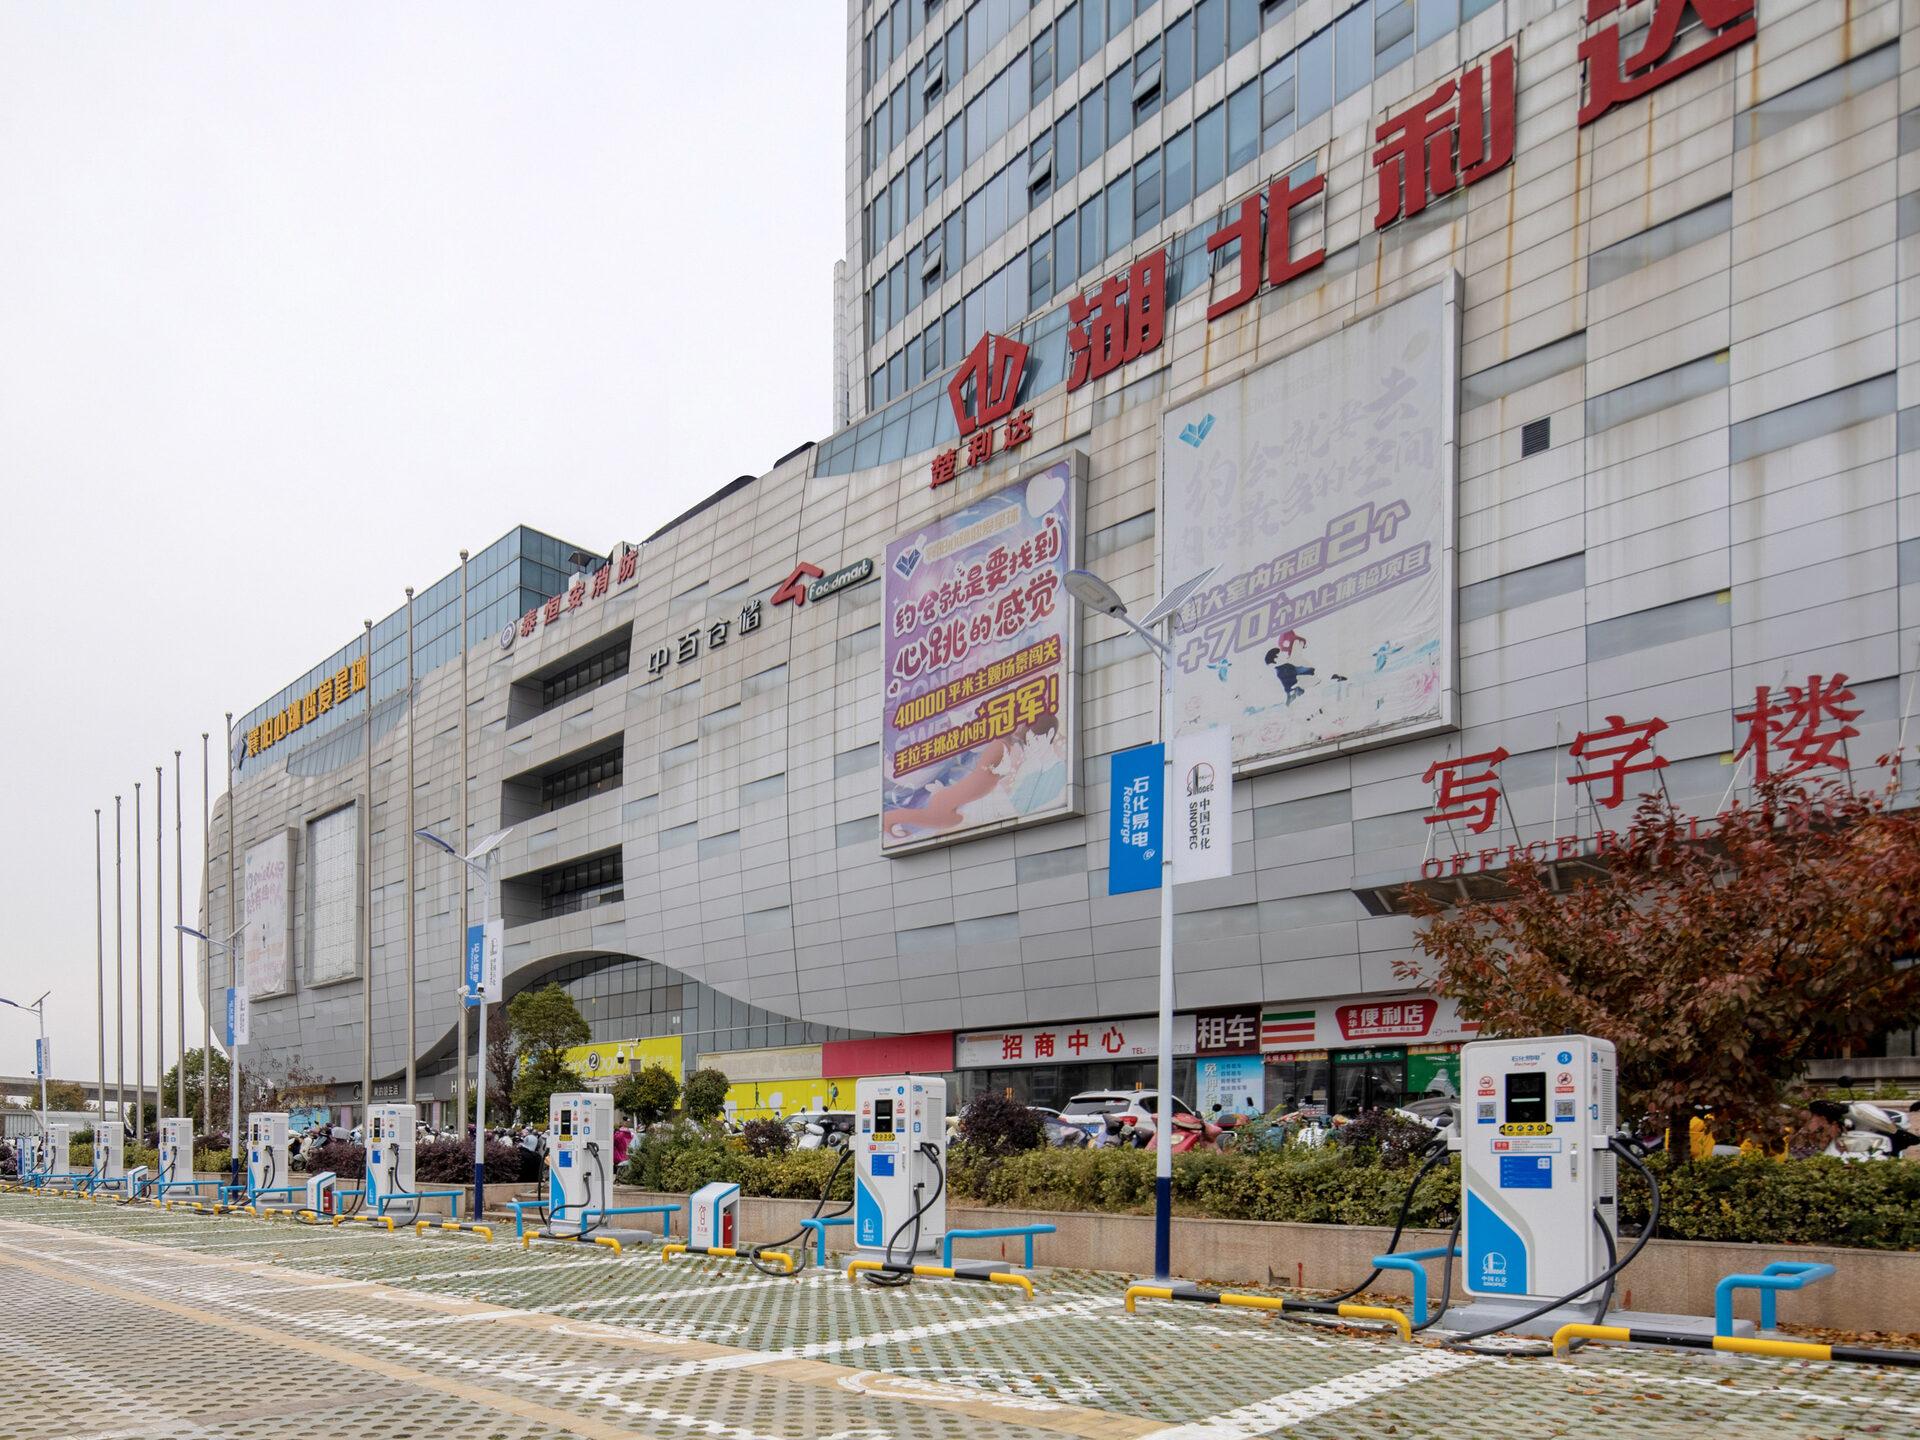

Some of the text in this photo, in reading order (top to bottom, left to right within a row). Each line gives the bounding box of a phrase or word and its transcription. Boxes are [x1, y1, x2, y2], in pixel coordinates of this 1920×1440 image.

[929, 408, 1034, 490] 楚利达
[895, 525, 1059, 633] 约会就是要找到
[646, 599, 762, 674] 中百仓储
[896, 569, 1058, 676] 心跳的感觉
[1421, 672, 1865, 834] 写字楼
[1120, 786, 1133, 845] Recharge
[1189, 802, 1198, 850] SINOPEC
[1199, 798, 1211, 850] 中国石化
[1420, 834, 1580, 881] OFFICE
[1197, 1014, 1257, 1049] 租车
[1361, 1004, 1424, 1027] 便利店
[589, 1053, 597, 1067] 2
[1002, 1026, 1126, 1060] 招商中心
